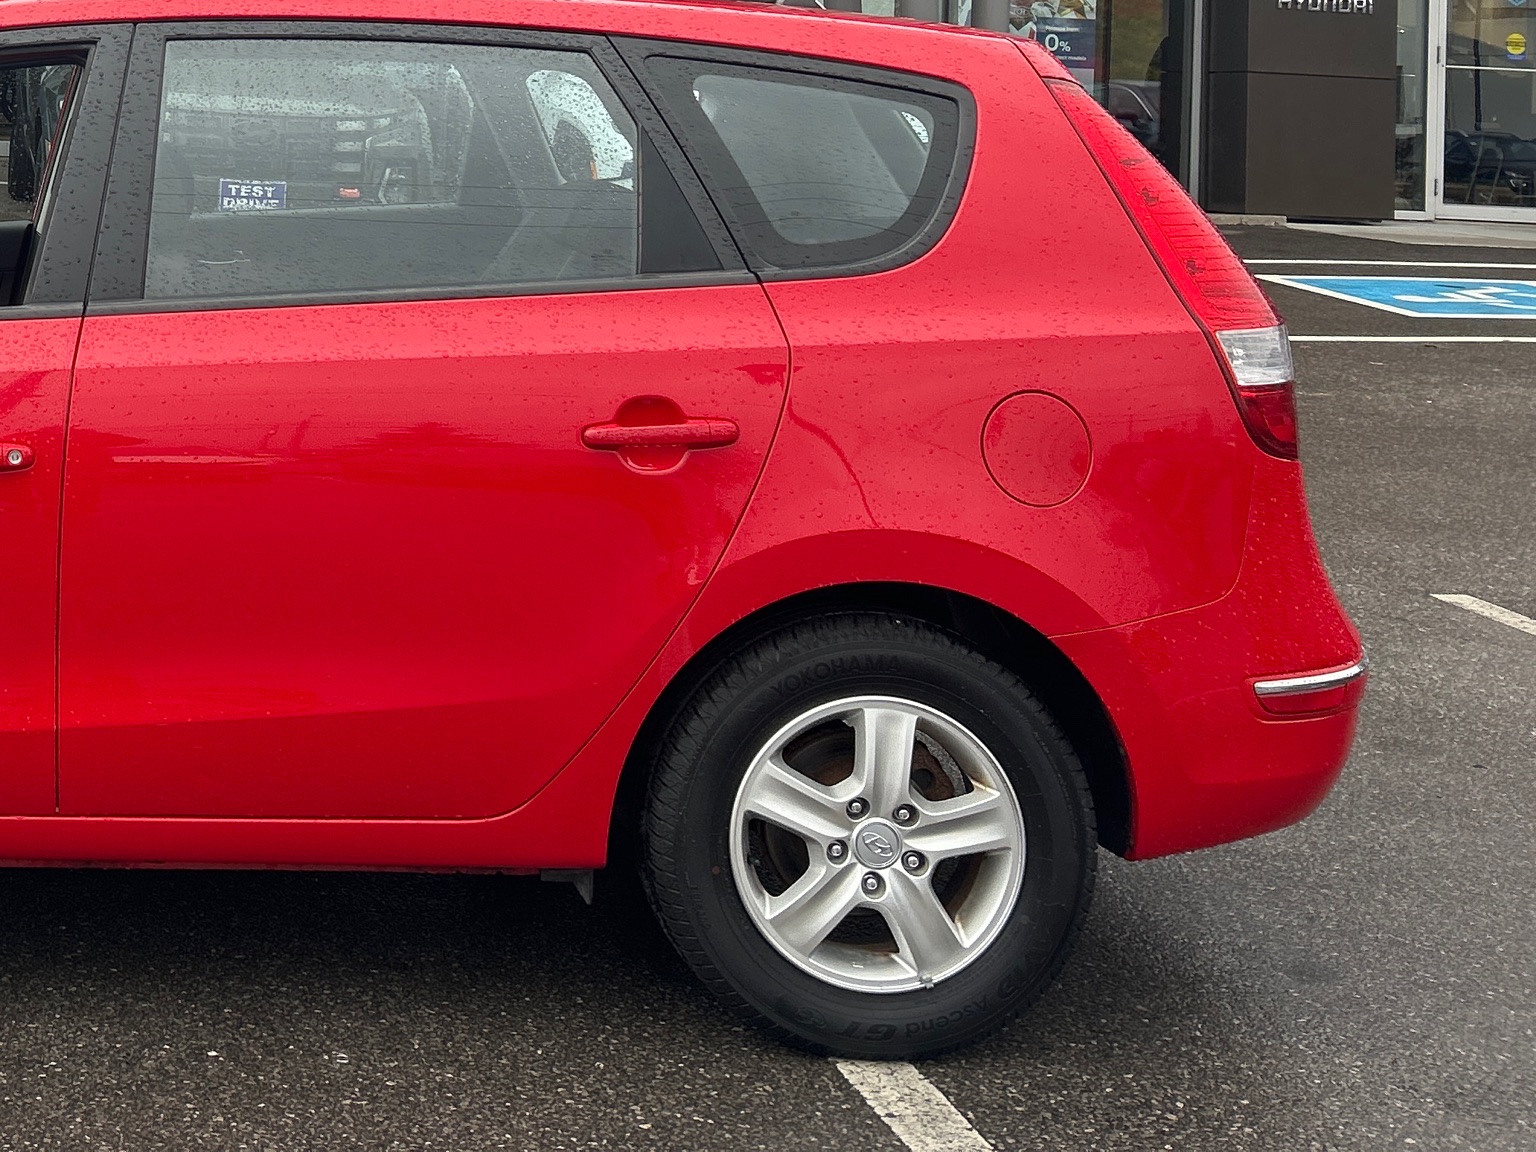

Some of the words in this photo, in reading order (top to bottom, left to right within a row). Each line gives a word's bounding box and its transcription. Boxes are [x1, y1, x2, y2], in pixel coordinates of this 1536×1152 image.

[1045, 33, 1071, 52] 0%
[228, 184, 275, 198] TEST
[223, 197, 279, 210] DRIVE
[770, 654, 902, 696] YOKOHAMA
